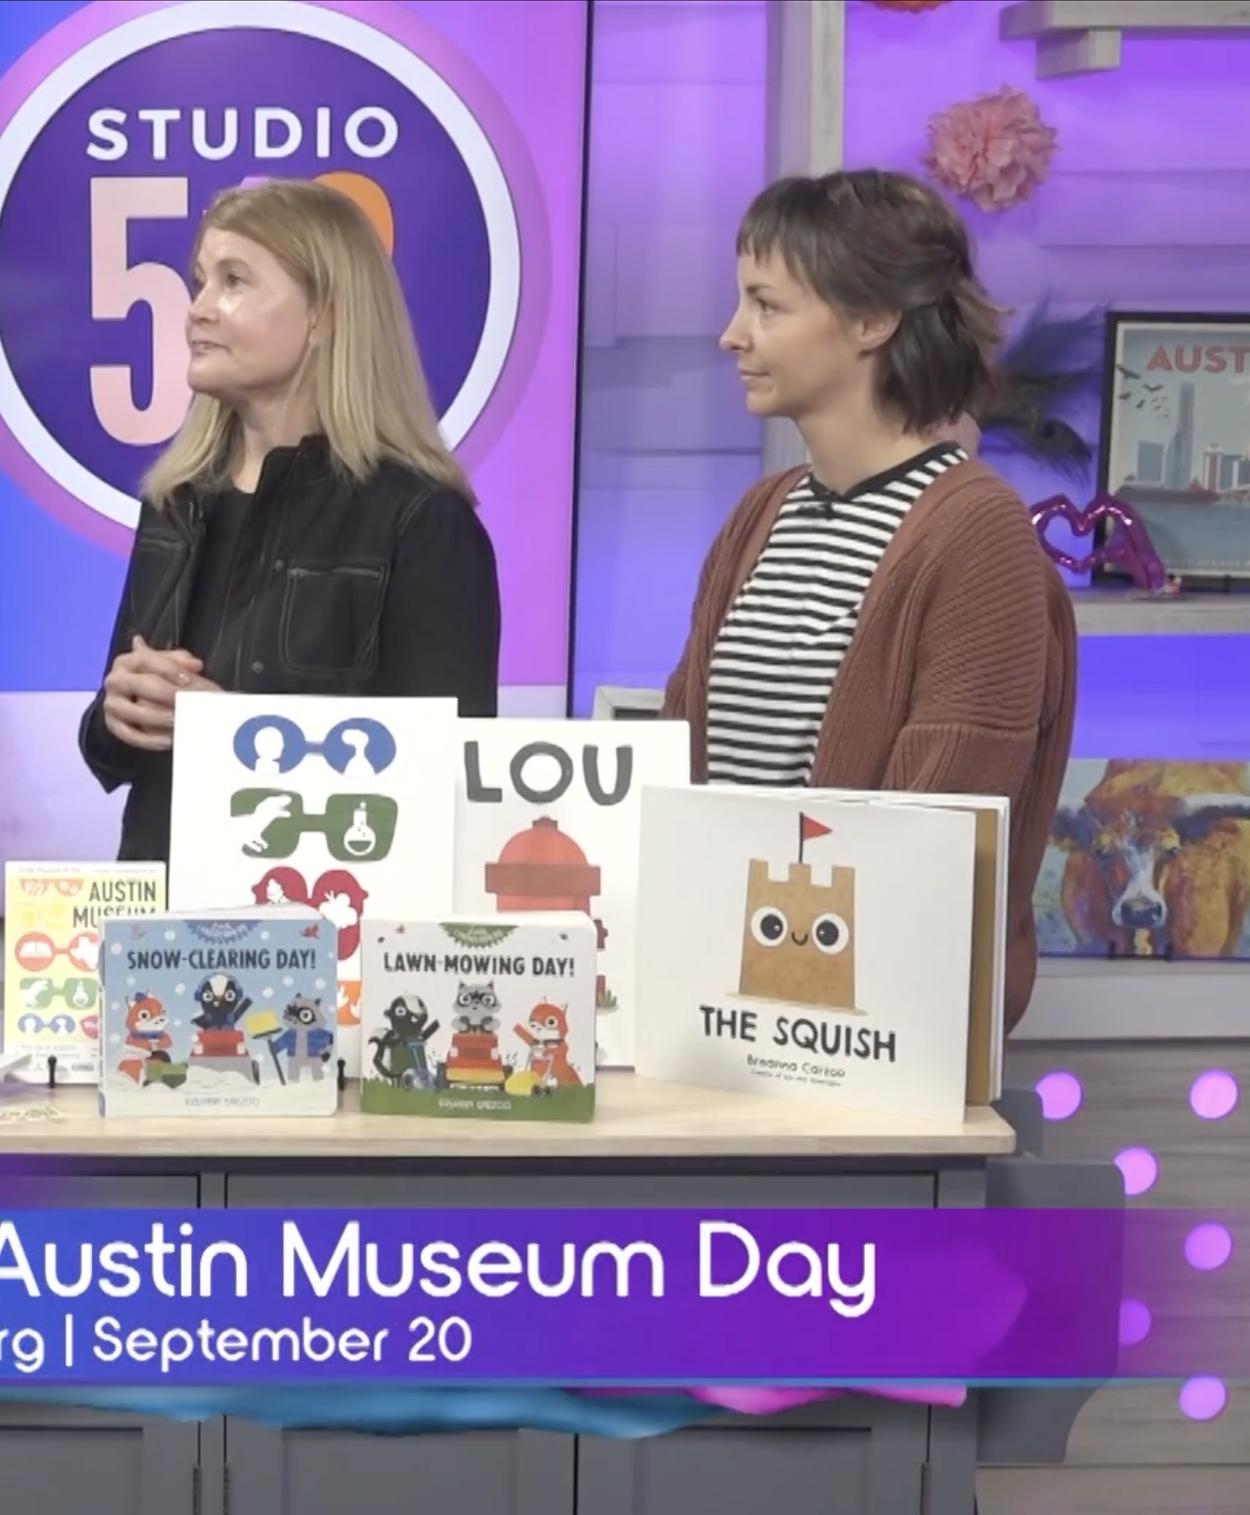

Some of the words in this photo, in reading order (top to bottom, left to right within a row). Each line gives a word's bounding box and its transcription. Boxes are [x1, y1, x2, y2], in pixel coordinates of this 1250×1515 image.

[86, 106, 399, 161] STUDIO
[463, 740, 634, 806] LOU
[88, 879, 157, 902] AUSTIN
[127, 948, 271, 970] SNOW-CLEARING
[276, 950, 317, 970] DAY!
[384, 952, 525, 976] LAWN-MOWING
[532, 957, 575, 977] DAY!
[699, 1005, 758, 1042] THE
[773, 1016, 897, 1063] SQUISH
